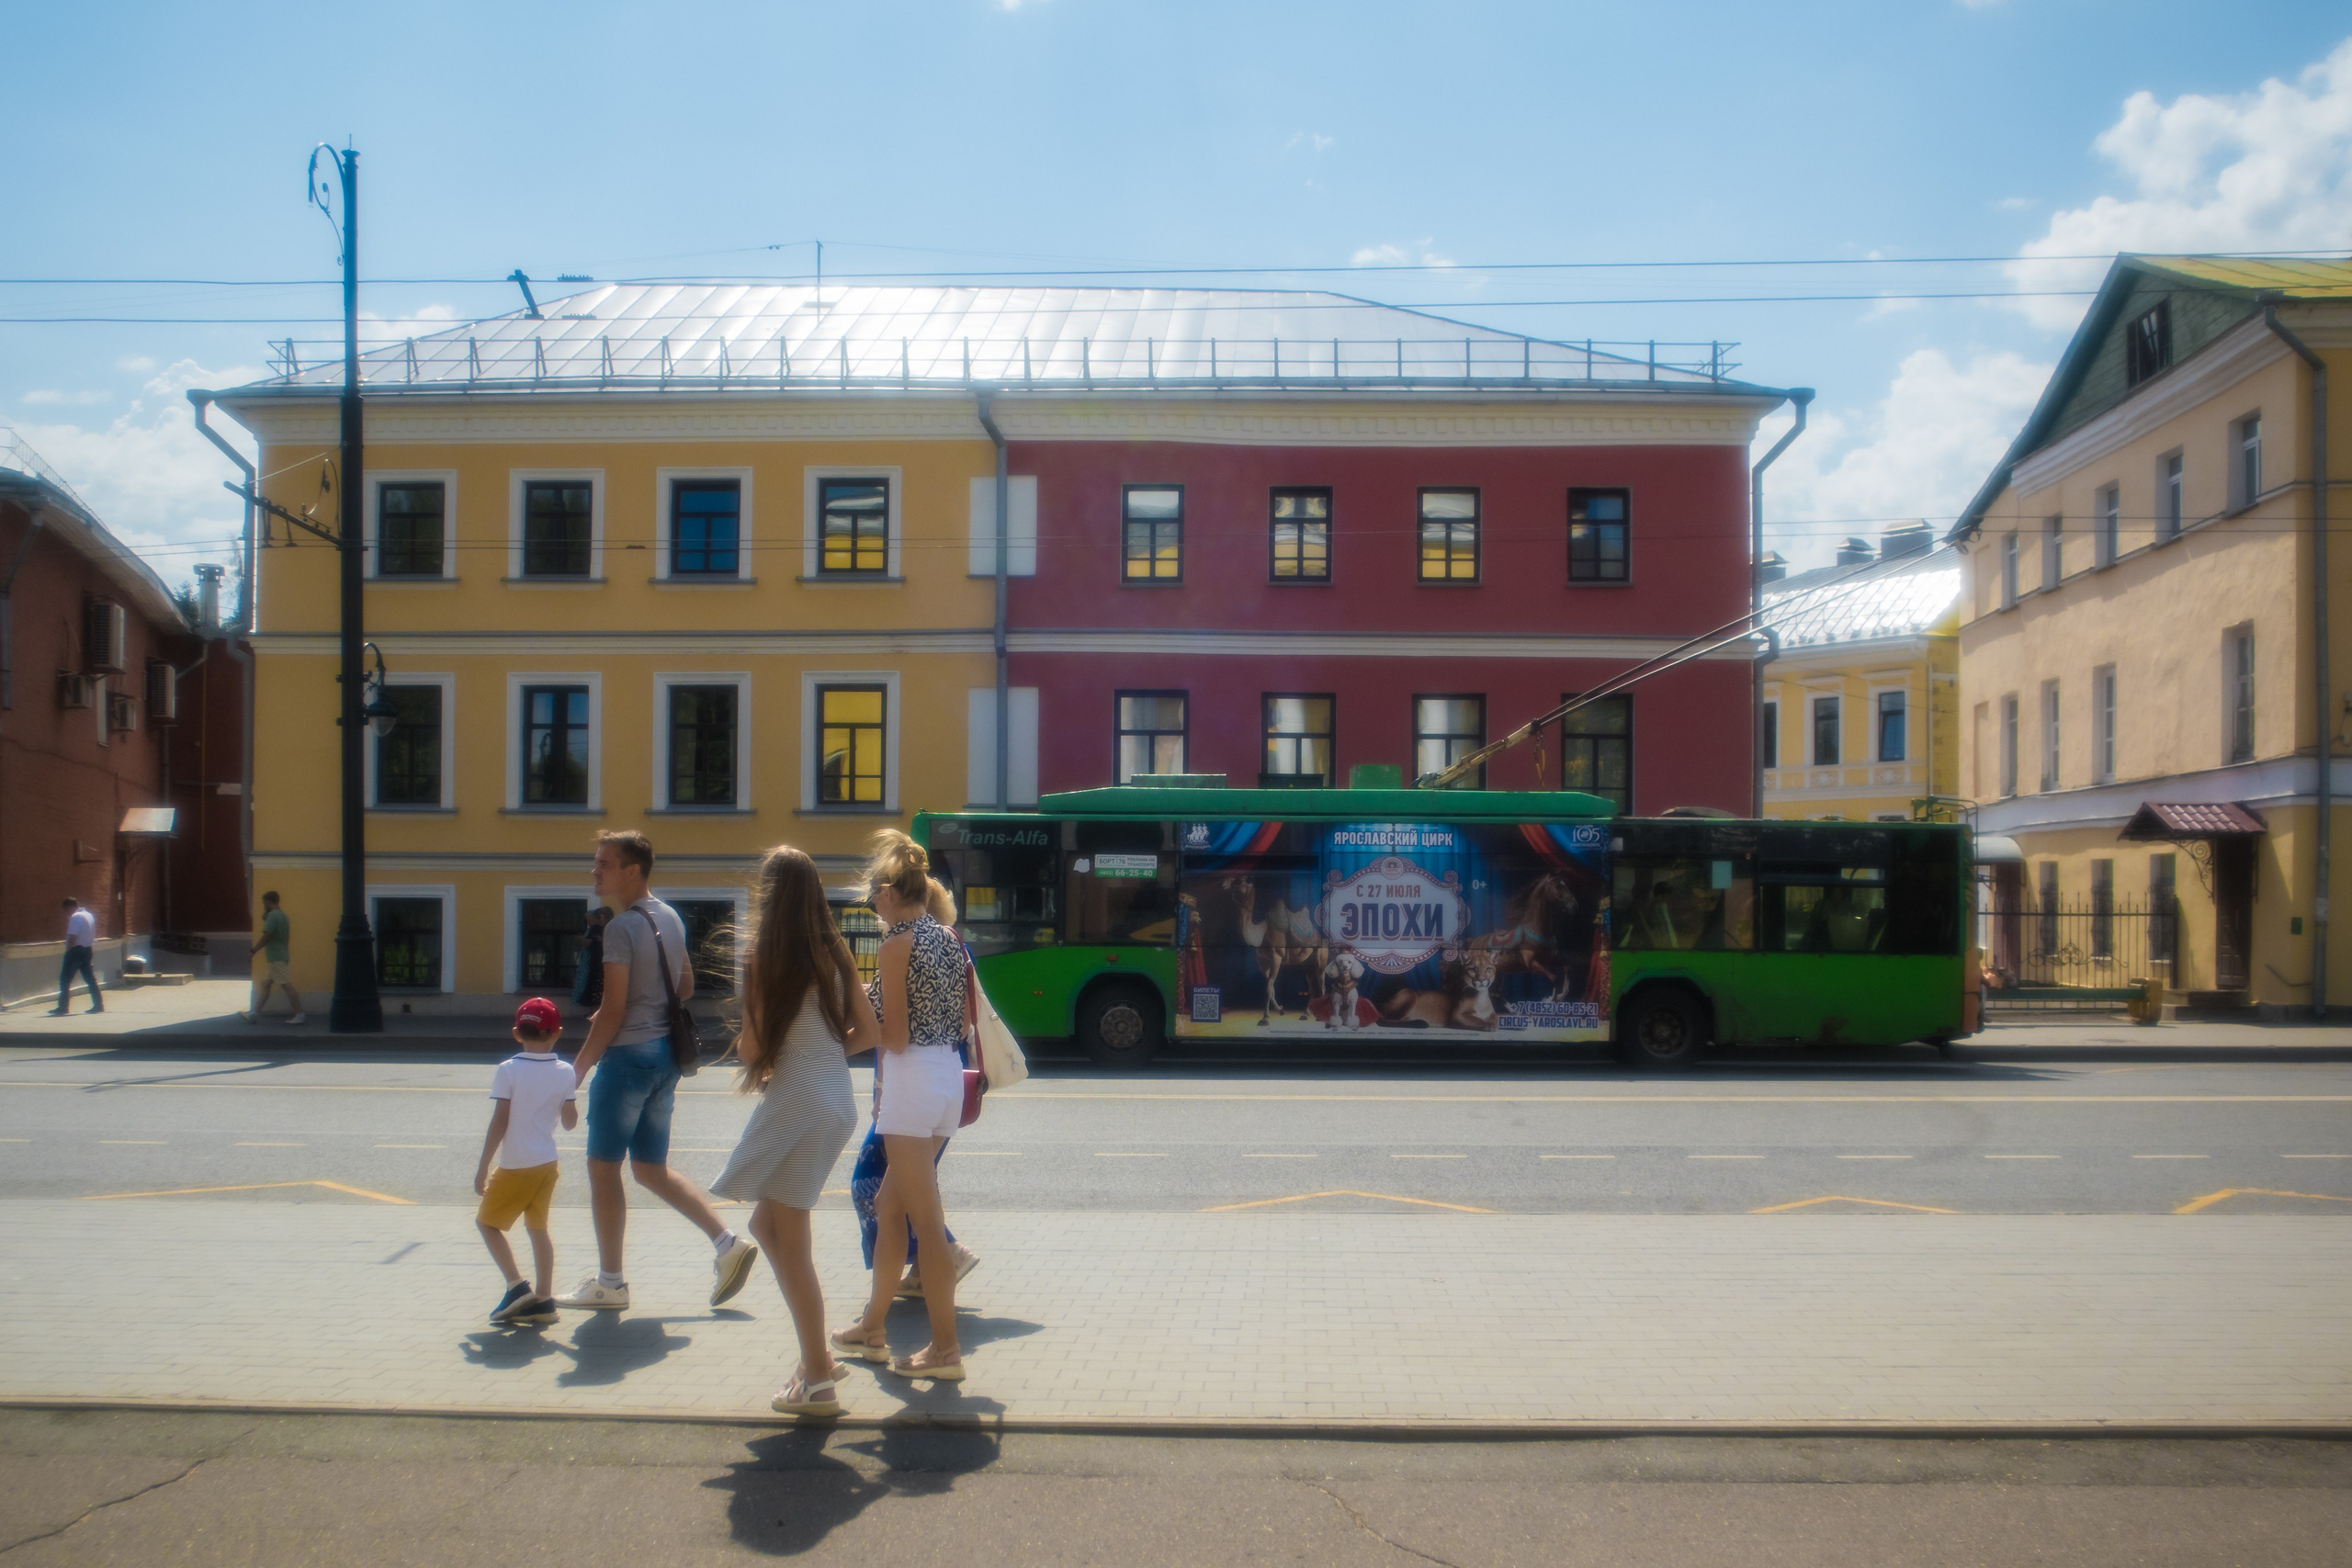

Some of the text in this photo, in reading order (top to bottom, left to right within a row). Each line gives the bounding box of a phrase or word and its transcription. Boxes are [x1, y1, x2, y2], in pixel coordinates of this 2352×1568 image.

[957, 829, 1048, 845] Trans-Alfa
[1334, 829, 1453, 848] ЯРОСЛАВСКИЙ ЦИРК
[1114, 869, 1153, 877] 66-25-40
[1356, 885, 1421, 898] С 27 ИЮЛЯ
[1472, 879, 1487, 890] 0+
[1340, 902, 1444, 942] ЭПОХИ
[1510, 1001, 1599, 1016] +7 (4852) 60-85-21
[1498, 1015, 1599, 1029] CIRCUS-YAROSLAVL.RU
